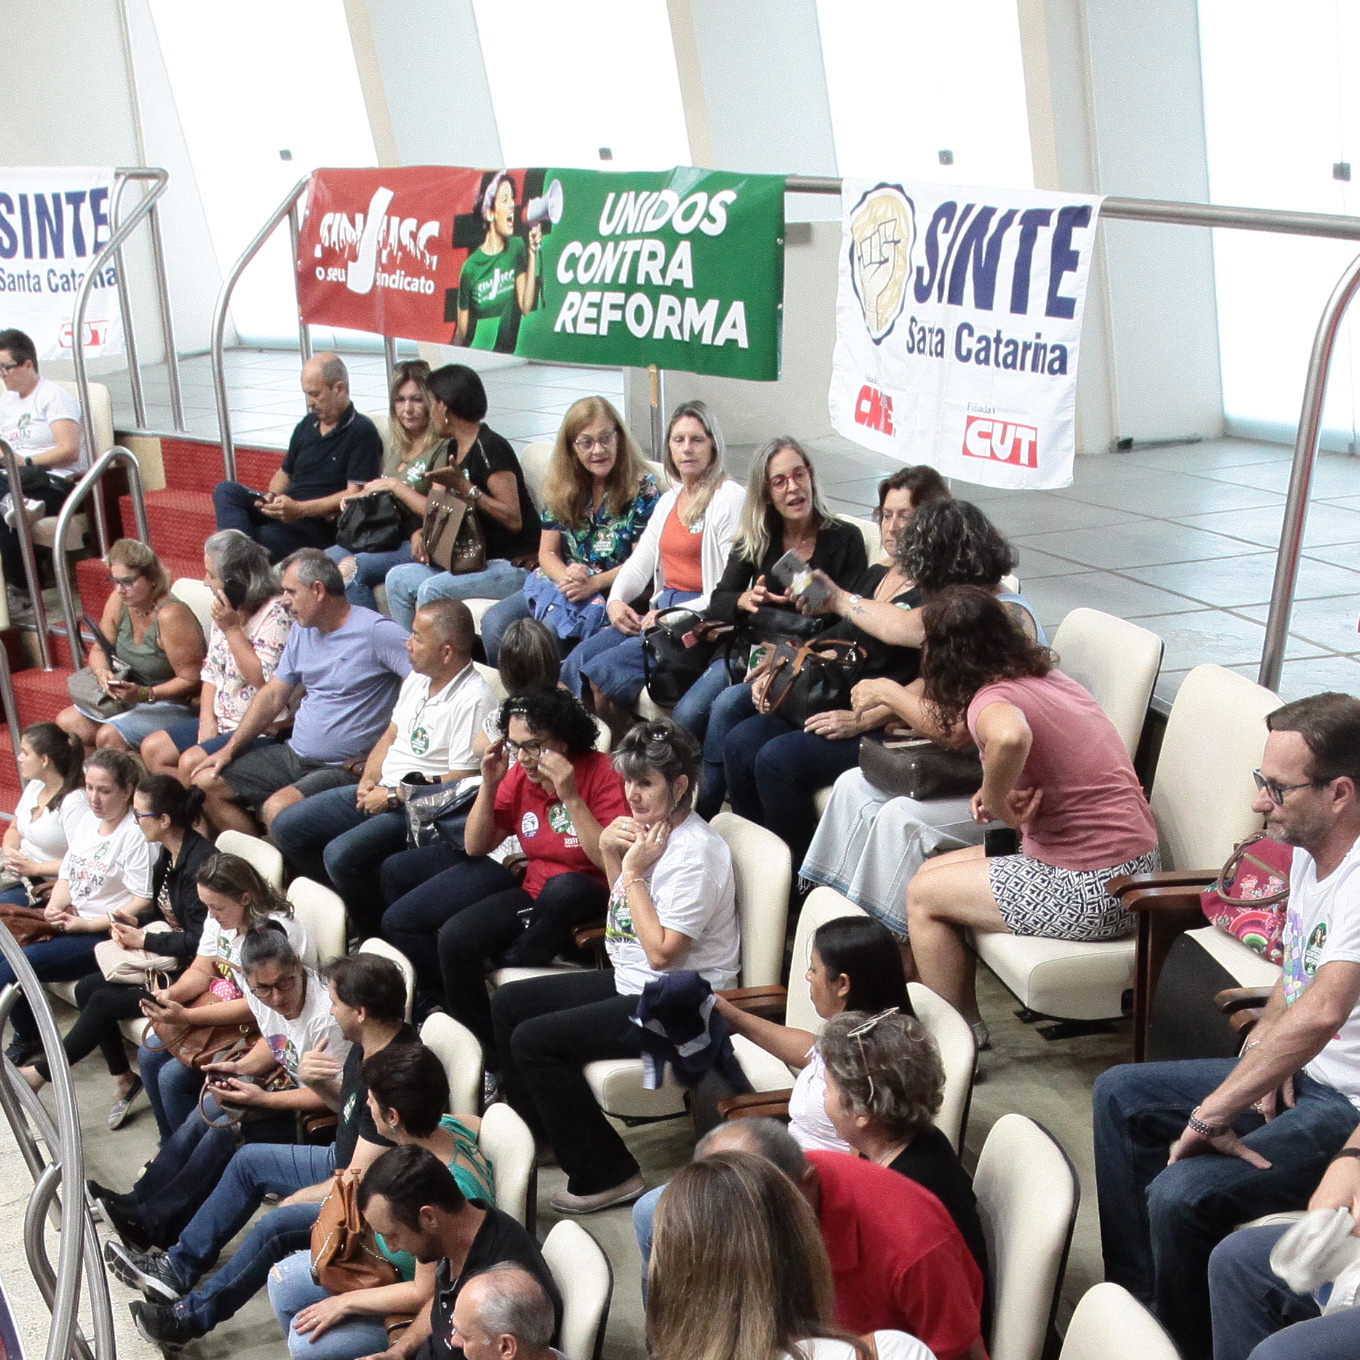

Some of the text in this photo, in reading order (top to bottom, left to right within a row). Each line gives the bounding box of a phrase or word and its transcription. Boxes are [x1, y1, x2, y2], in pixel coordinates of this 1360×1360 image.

[600, 189, 737, 237] UNIDOS
[315, 266, 436, 295] o seu sindicato
[557, 239, 693, 289] CONTRA
[913, 200, 1092, 320] SINTE
[555, 291, 749, 349] REFORMA
[954, 321, 1068, 376] Catarina
[964, 419, 1037, 465] CUT
